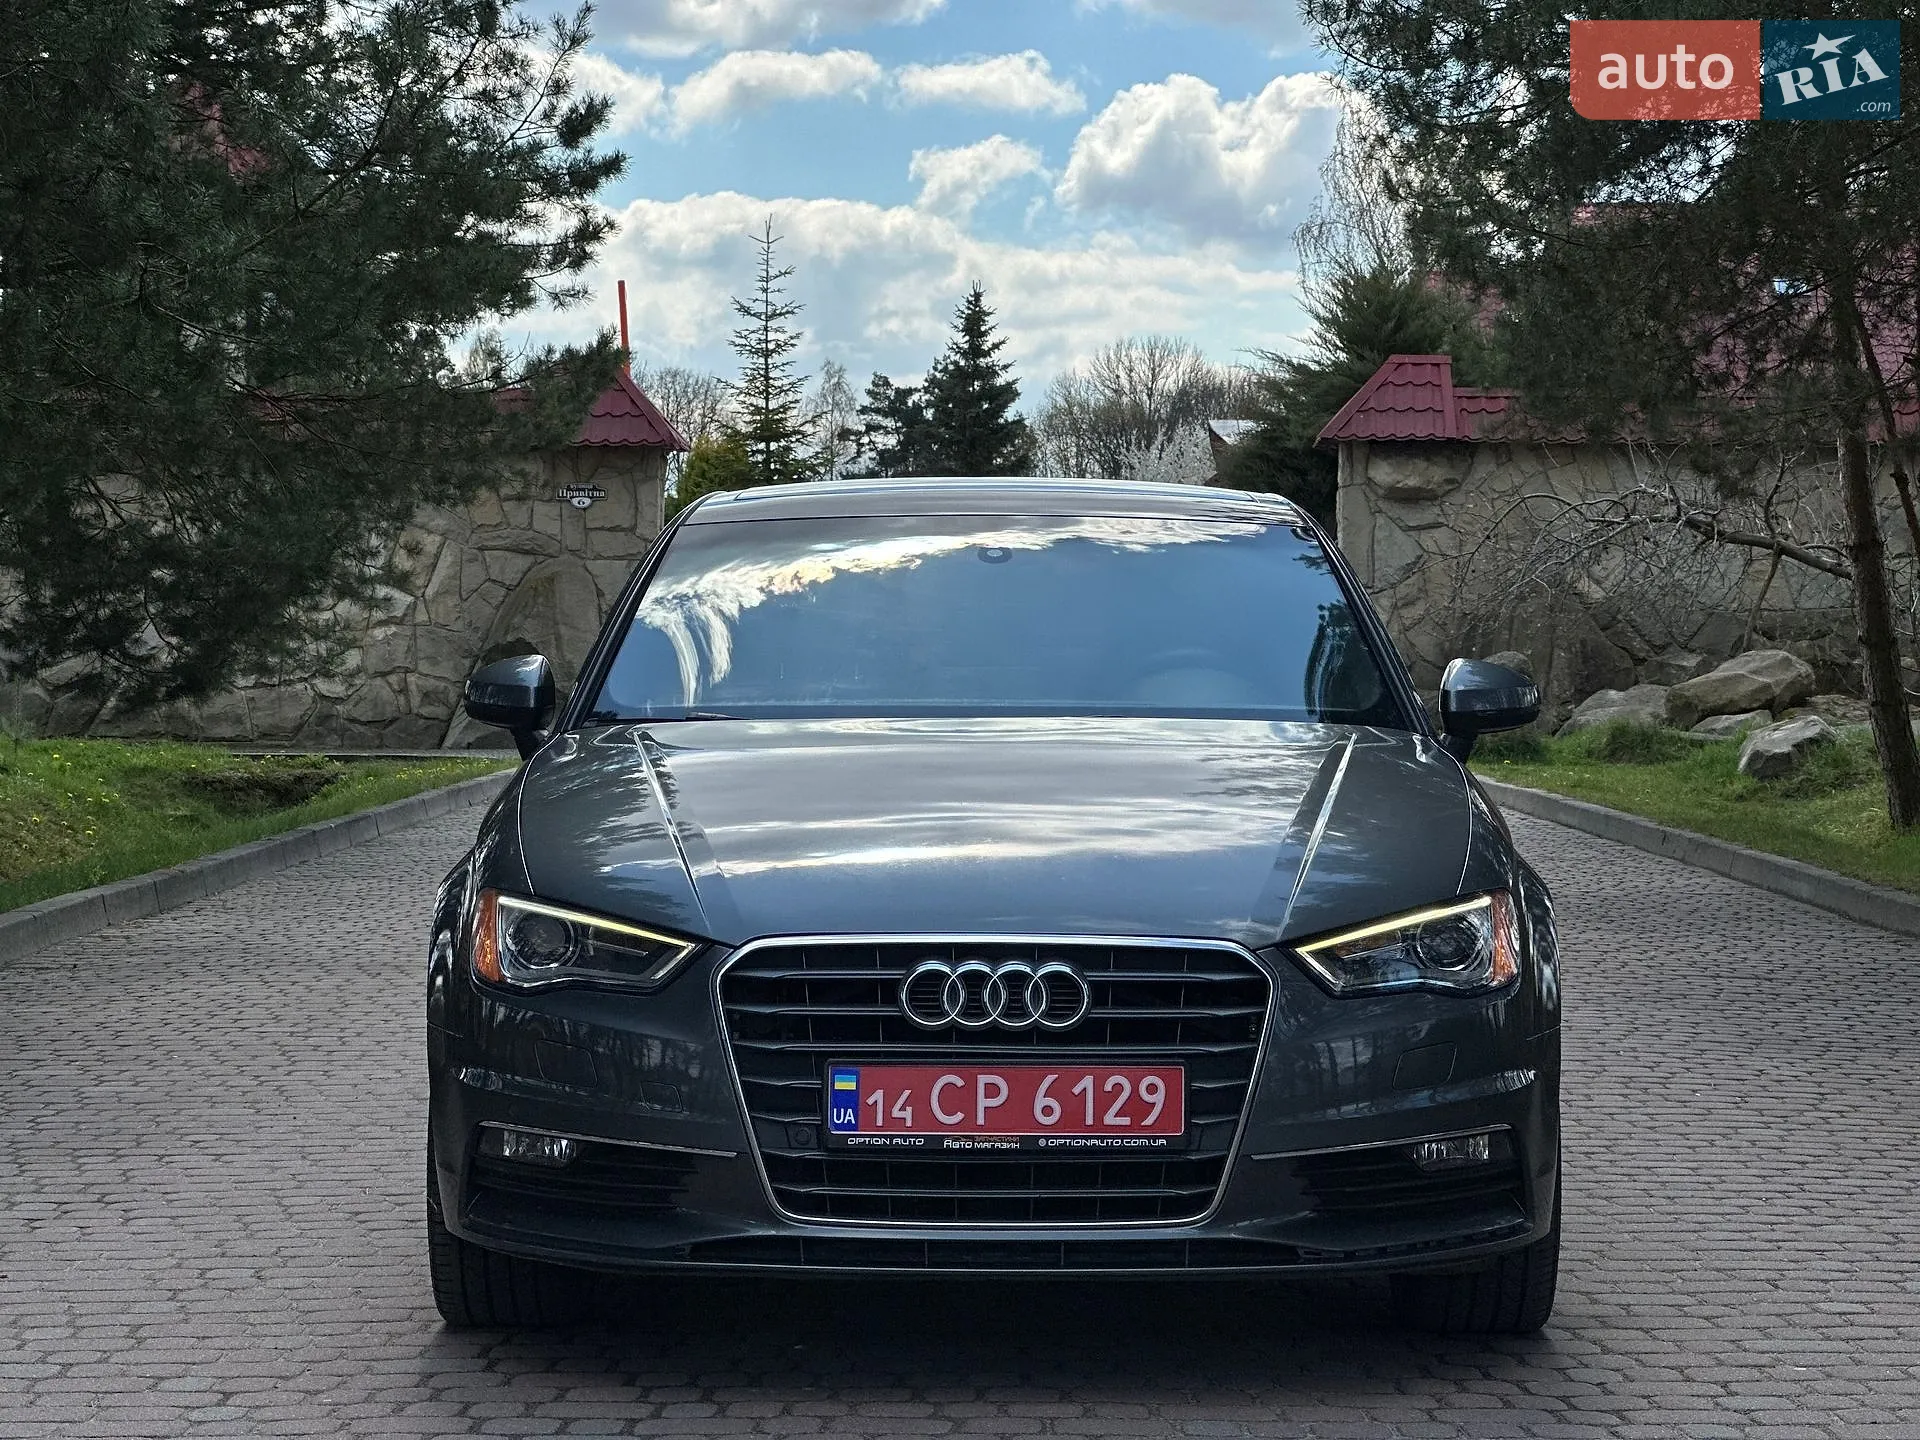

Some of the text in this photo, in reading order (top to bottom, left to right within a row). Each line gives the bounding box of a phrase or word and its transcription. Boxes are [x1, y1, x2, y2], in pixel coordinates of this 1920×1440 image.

[866, 1074, 1166, 1127] 14 CP 6129
[833, 1108, 855, 1124] UA
[892, 1138, 924, 1146] AUTO
